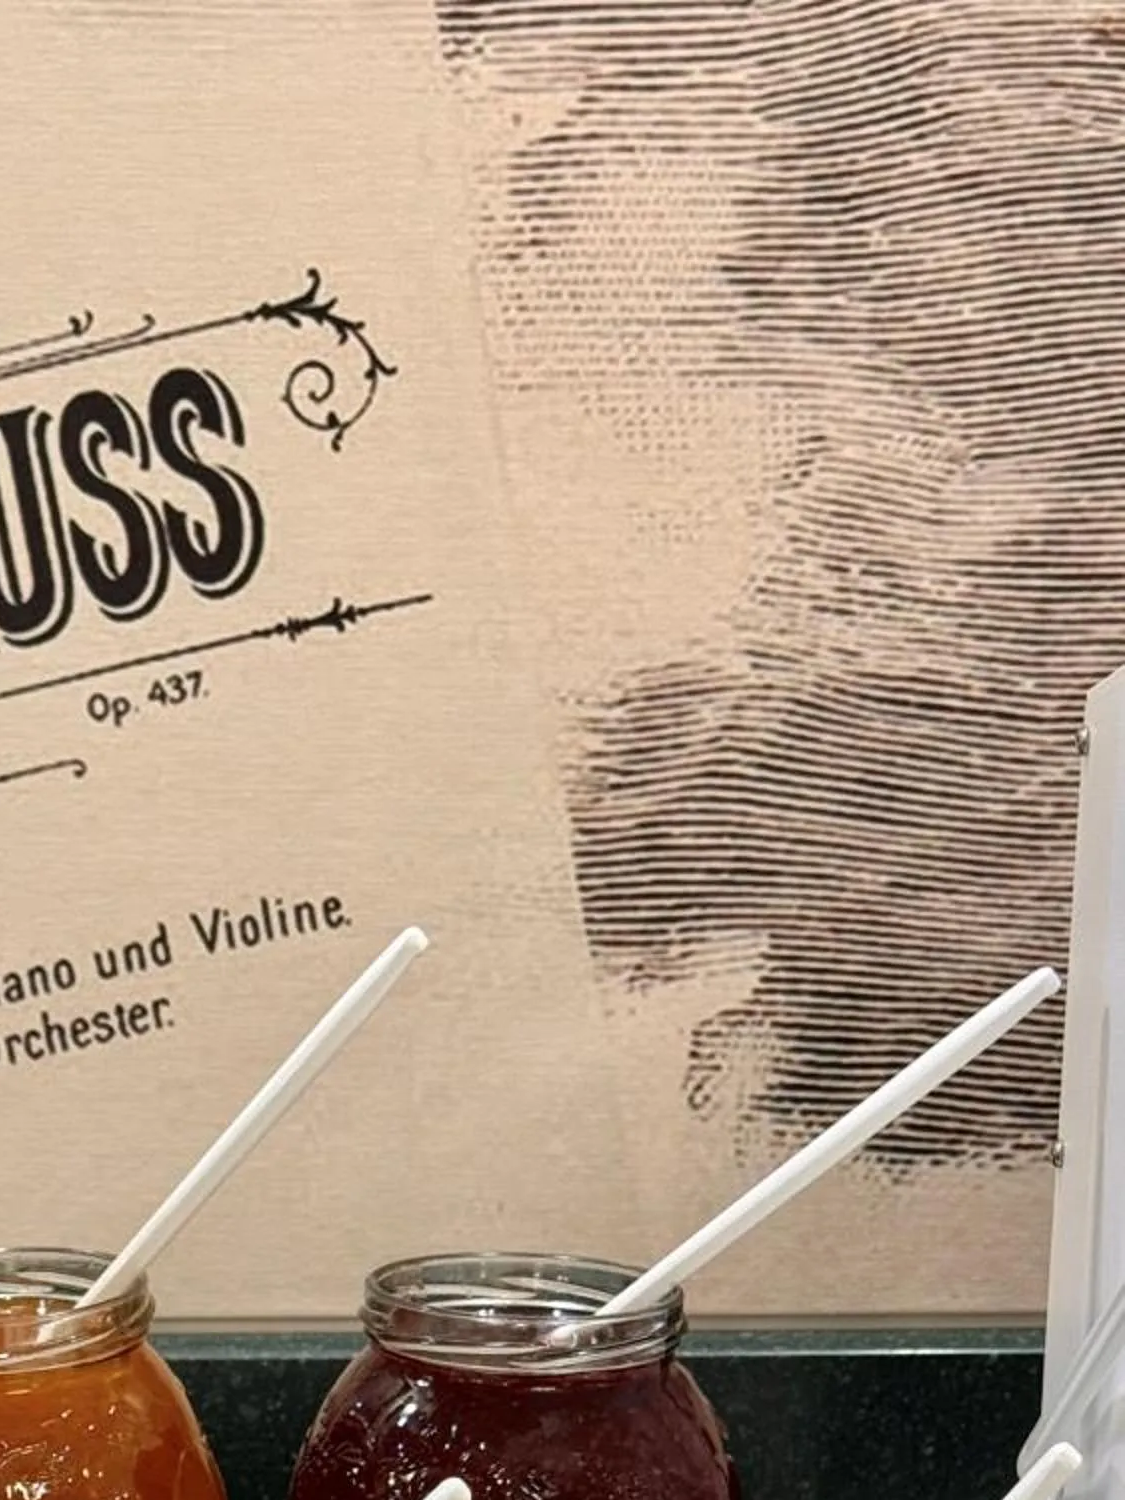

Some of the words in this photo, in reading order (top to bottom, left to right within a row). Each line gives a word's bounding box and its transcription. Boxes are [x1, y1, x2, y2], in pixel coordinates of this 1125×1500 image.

[88, 692, 140, 727] Op.
[148, 670, 210, 707] 437.
[93, 922, 173, 981] und
[189, 895, 352, 954] Violine.
